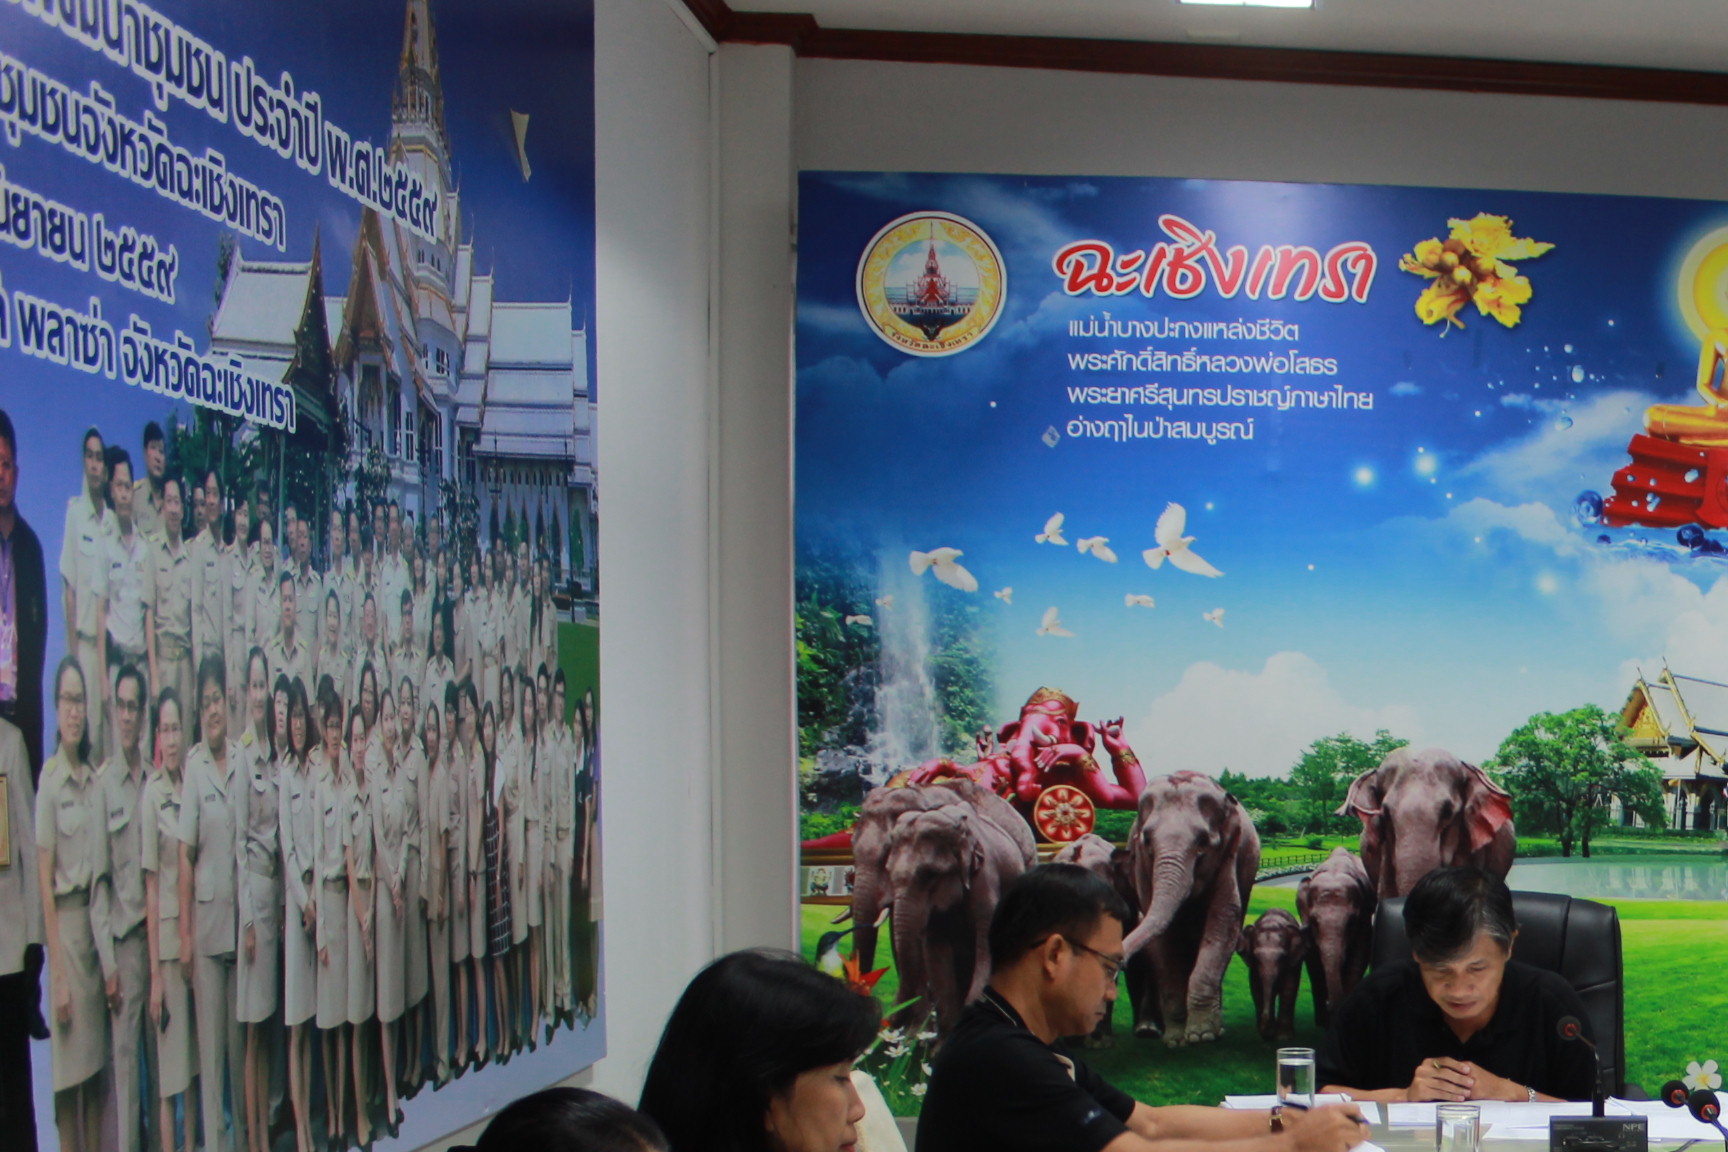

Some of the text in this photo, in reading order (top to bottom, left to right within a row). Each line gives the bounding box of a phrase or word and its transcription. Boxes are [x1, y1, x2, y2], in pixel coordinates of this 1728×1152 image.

[231, 55, 322, 175] ประจำปี
[325, 120, 438, 245] พ.ศ.๒๕๕๙
[93, 213, 178, 304] ๒๕๕๙
[1052, 213, 1377, 303] ฉะเชิงเทรา
[1068, 311, 1299, 341] แม่น้ำบางปะกงแหล่งชีวิต
[14, 291, 117, 379] พลาซ่า
[120, 314, 296, 433] จังหวัดฉะเชิงเทรา
[1067, 347, 1338, 375] พระศักดิ์สิทธิ์หลวงพ่อโสธร
[1067, 383, 1374, 411] พระยาศรีสุนทรปราชญ์ภาษาไทย
[1622, 1123, 1645, 1131] NPE
